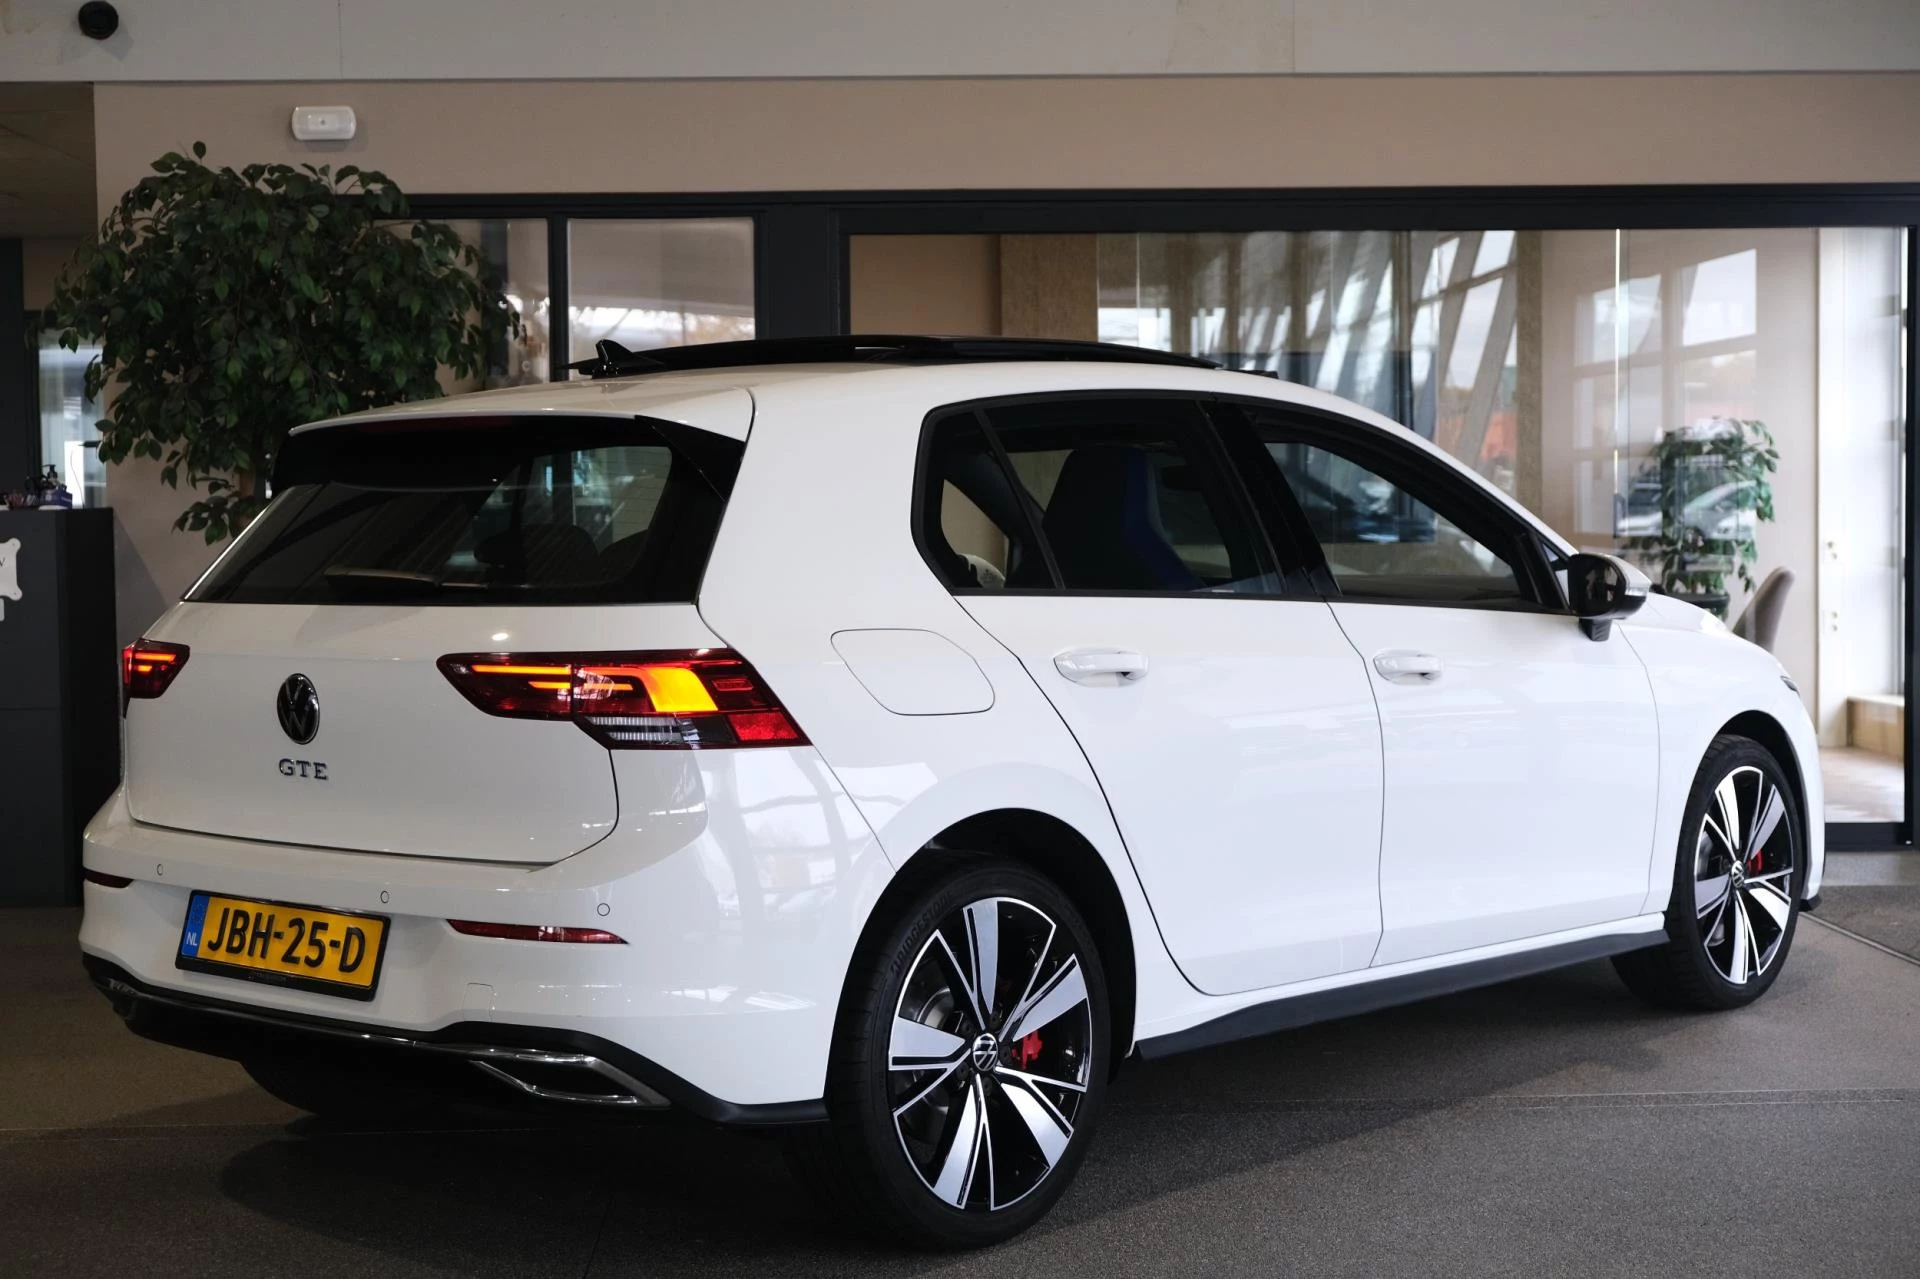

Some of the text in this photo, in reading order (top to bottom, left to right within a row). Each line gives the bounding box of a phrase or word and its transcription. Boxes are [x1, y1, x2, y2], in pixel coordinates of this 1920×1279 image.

[279, 758, 328, 780] GTE
[186, 931, 198, 947] NL
[207, 907, 366, 974] JBH-25-D
